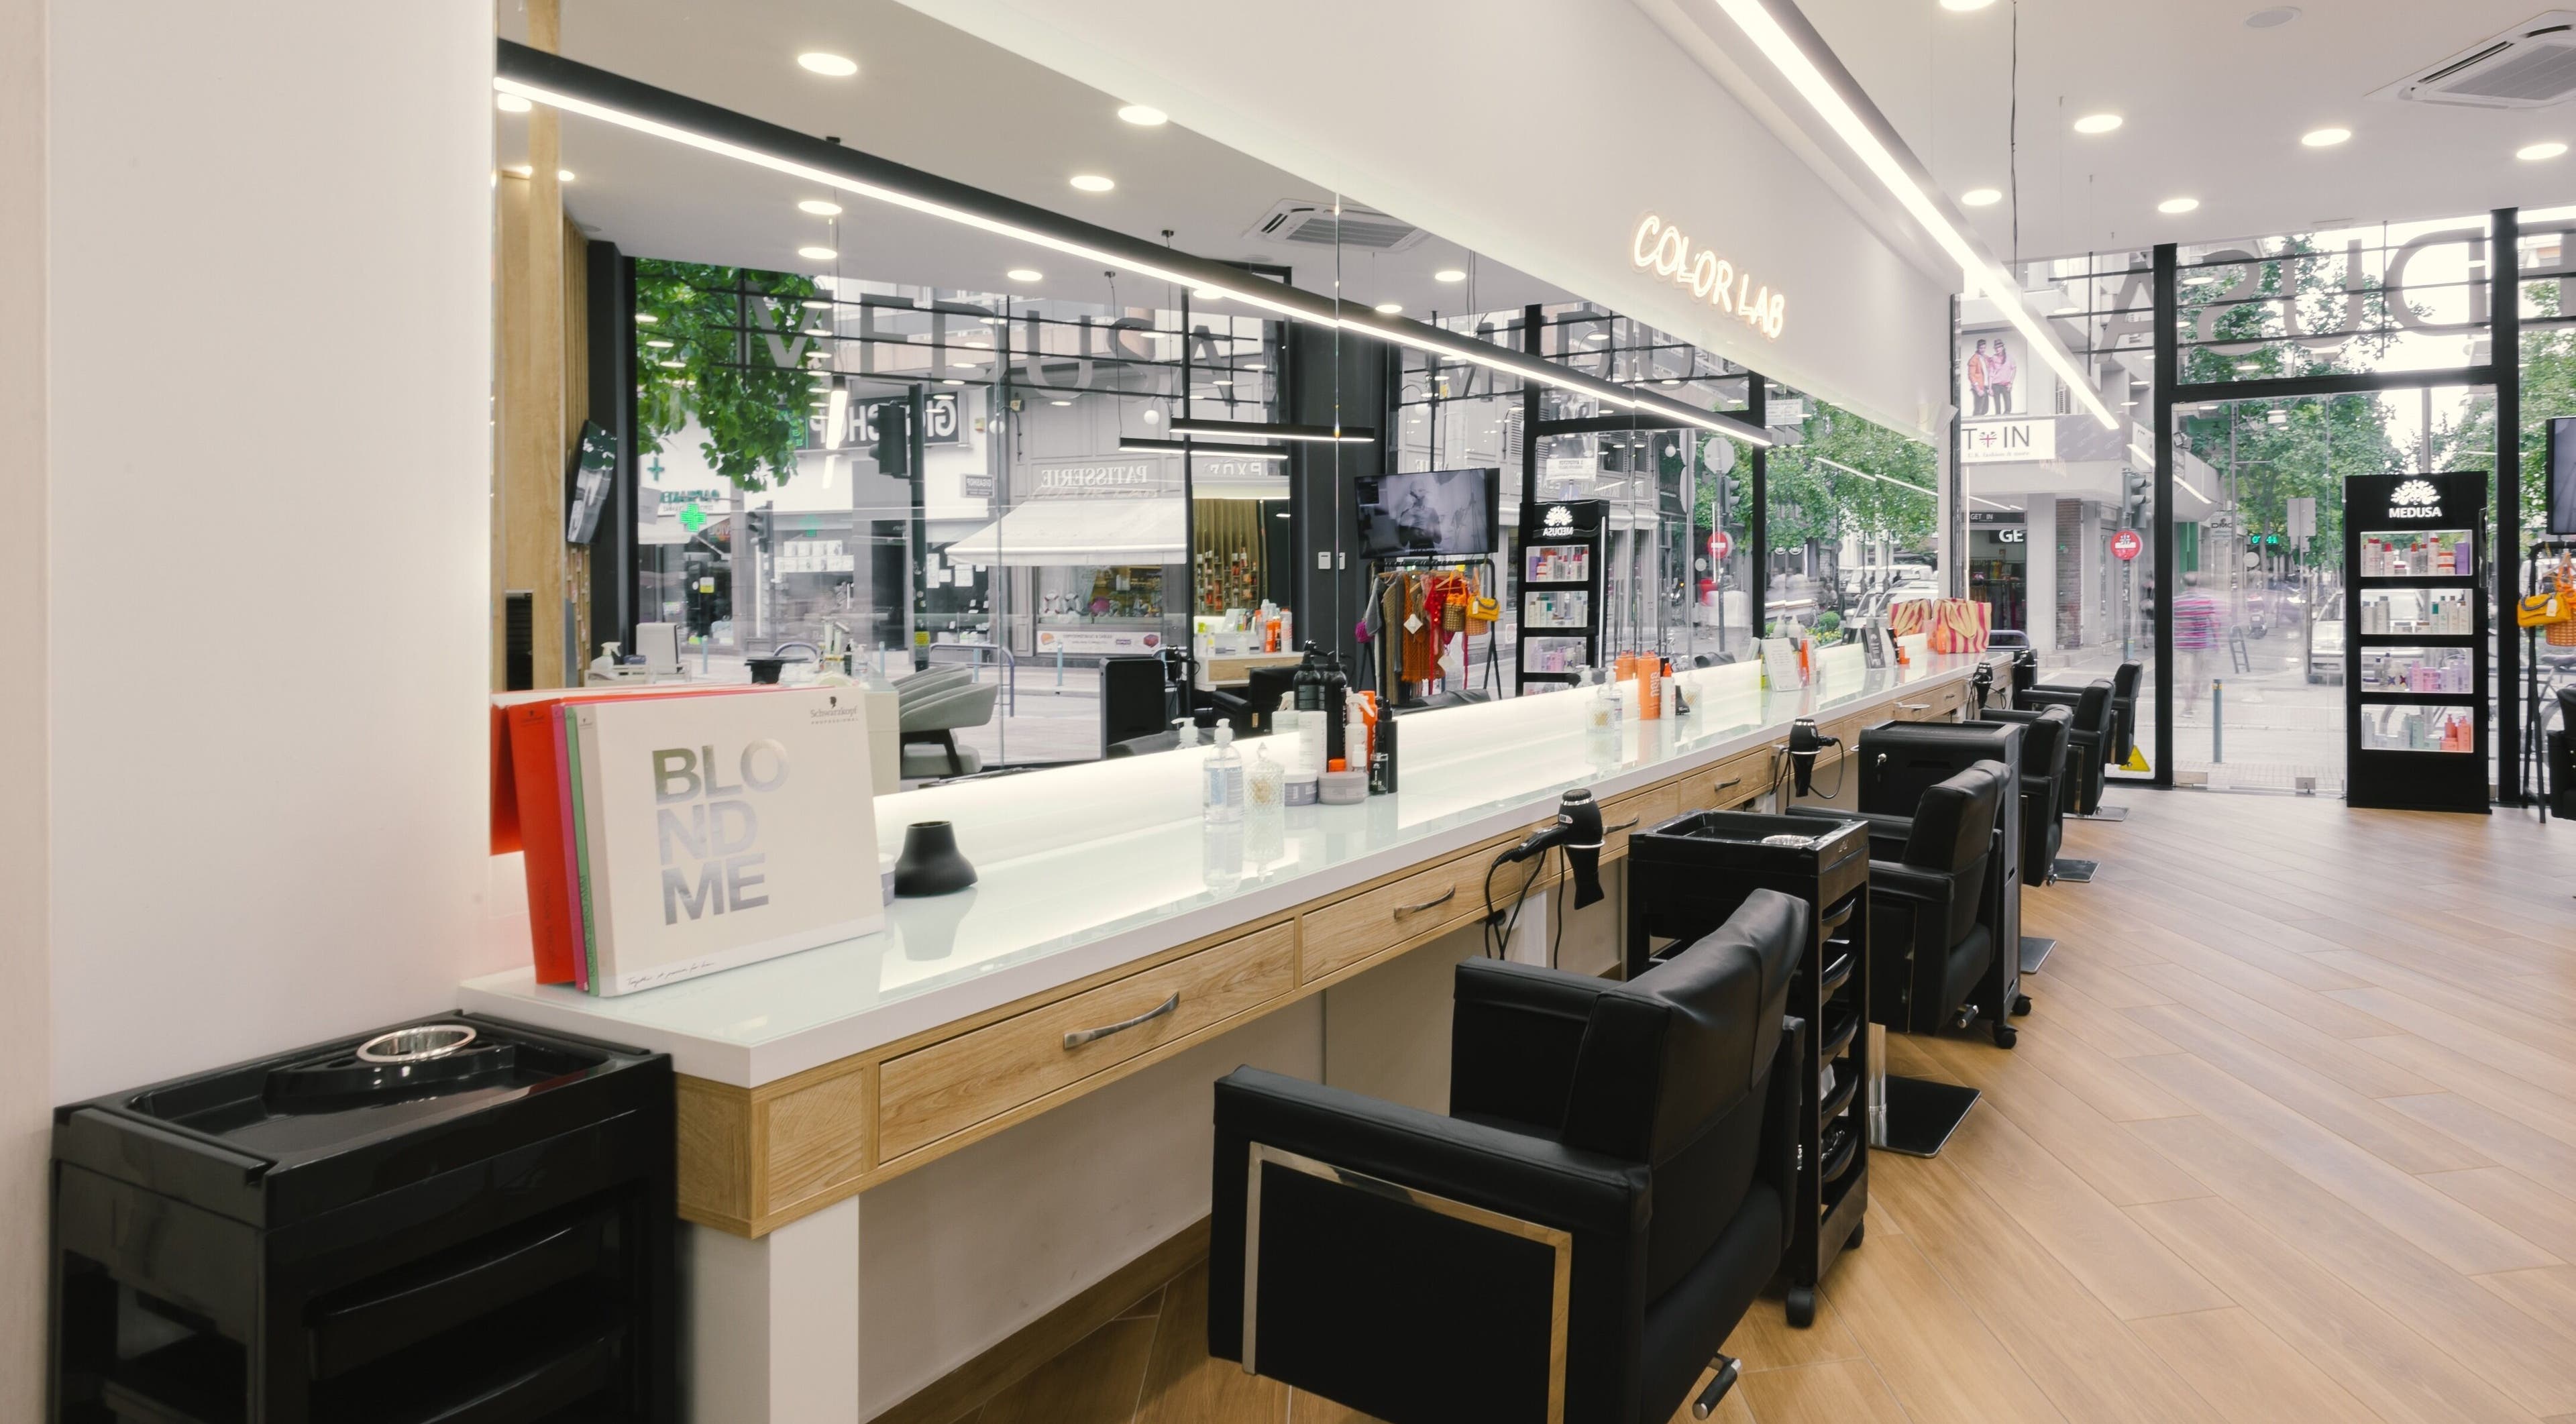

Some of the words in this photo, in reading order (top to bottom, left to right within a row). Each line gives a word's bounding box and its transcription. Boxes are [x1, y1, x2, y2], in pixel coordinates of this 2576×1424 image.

[1634, 215, 1733, 312] COLOR
[1738, 274, 1784, 338] LAB
[2003, 425, 2029, 448] IN
[2389, 506, 2443, 518] MEDUSA
[810, 705, 858, 718] Schwarzkopf
[652, 738, 790, 804] BLO
[657, 800, 758, 865] ND
[662, 853, 769, 926] ME
